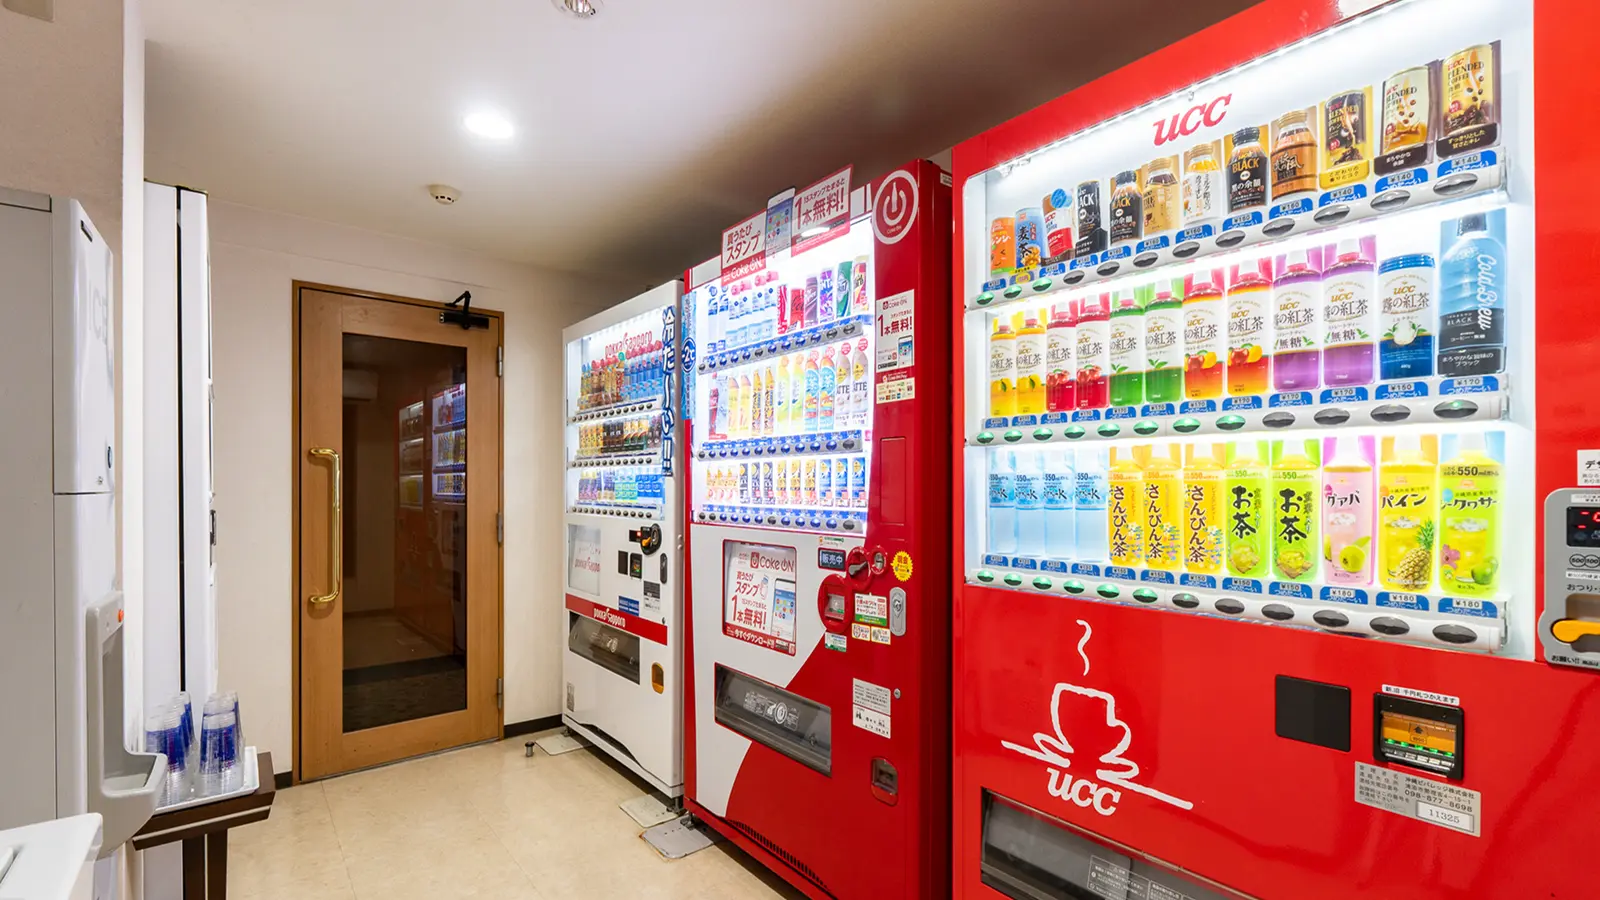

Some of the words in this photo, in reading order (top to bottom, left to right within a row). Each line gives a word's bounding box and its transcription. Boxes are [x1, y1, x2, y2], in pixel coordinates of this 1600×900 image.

[1448, 129, 1486, 144] すっきりとした
[1231, 157, 1260, 173] BLACK
[1454, 155, 1478, 165] ¥140
[1389, 172, 1412, 183] ¥140
[1332, 188, 1352, 198] ¥140
[795, 187, 845, 230] 1本無料!
[1282, 201, 1300, 211] ¥160
[727, 230, 761, 263] スタンプ
[1477, 254, 1498, 296] Cold
[1382, 293, 1429, 311] 霧の紅茶
[1477, 291, 1498, 331] Brew
[1447, 316, 1472, 326] BLACK
[1279, 336, 1302, 349] 無糖
[1331, 329, 1356, 343] 無糖
[1455, 359, 1480, 368] ブラック
[1456, 378, 1480, 386] ¥170
[1333, 389, 1354, 397] ¥170
[1327, 491, 1361, 507] グァバ
[1381, 494, 1427, 509] パイン
[1231, 485, 1257, 539] お茶
[1279, 488, 1308, 544] お茶
[1112, 485, 1128, 557] さんぴん茶
[1148, 484, 1163, 559] さんぴん茶
[1189, 486, 1206, 563] さんぴん茶
[760, 555, 780, 571] Coke
[780, 558, 795, 573] ON
[822, 553, 843, 565] 販売中
[735, 581, 760, 597] スタンプ
[1281, 583, 1300, 591] ¥150
[1332, 589, 1352, 597] ¥180
[1393, 594, 1415, 602] ¥180
[1455, 600, 1480, 608] ¥180
[1429, 809, 1460, 824] 11325
